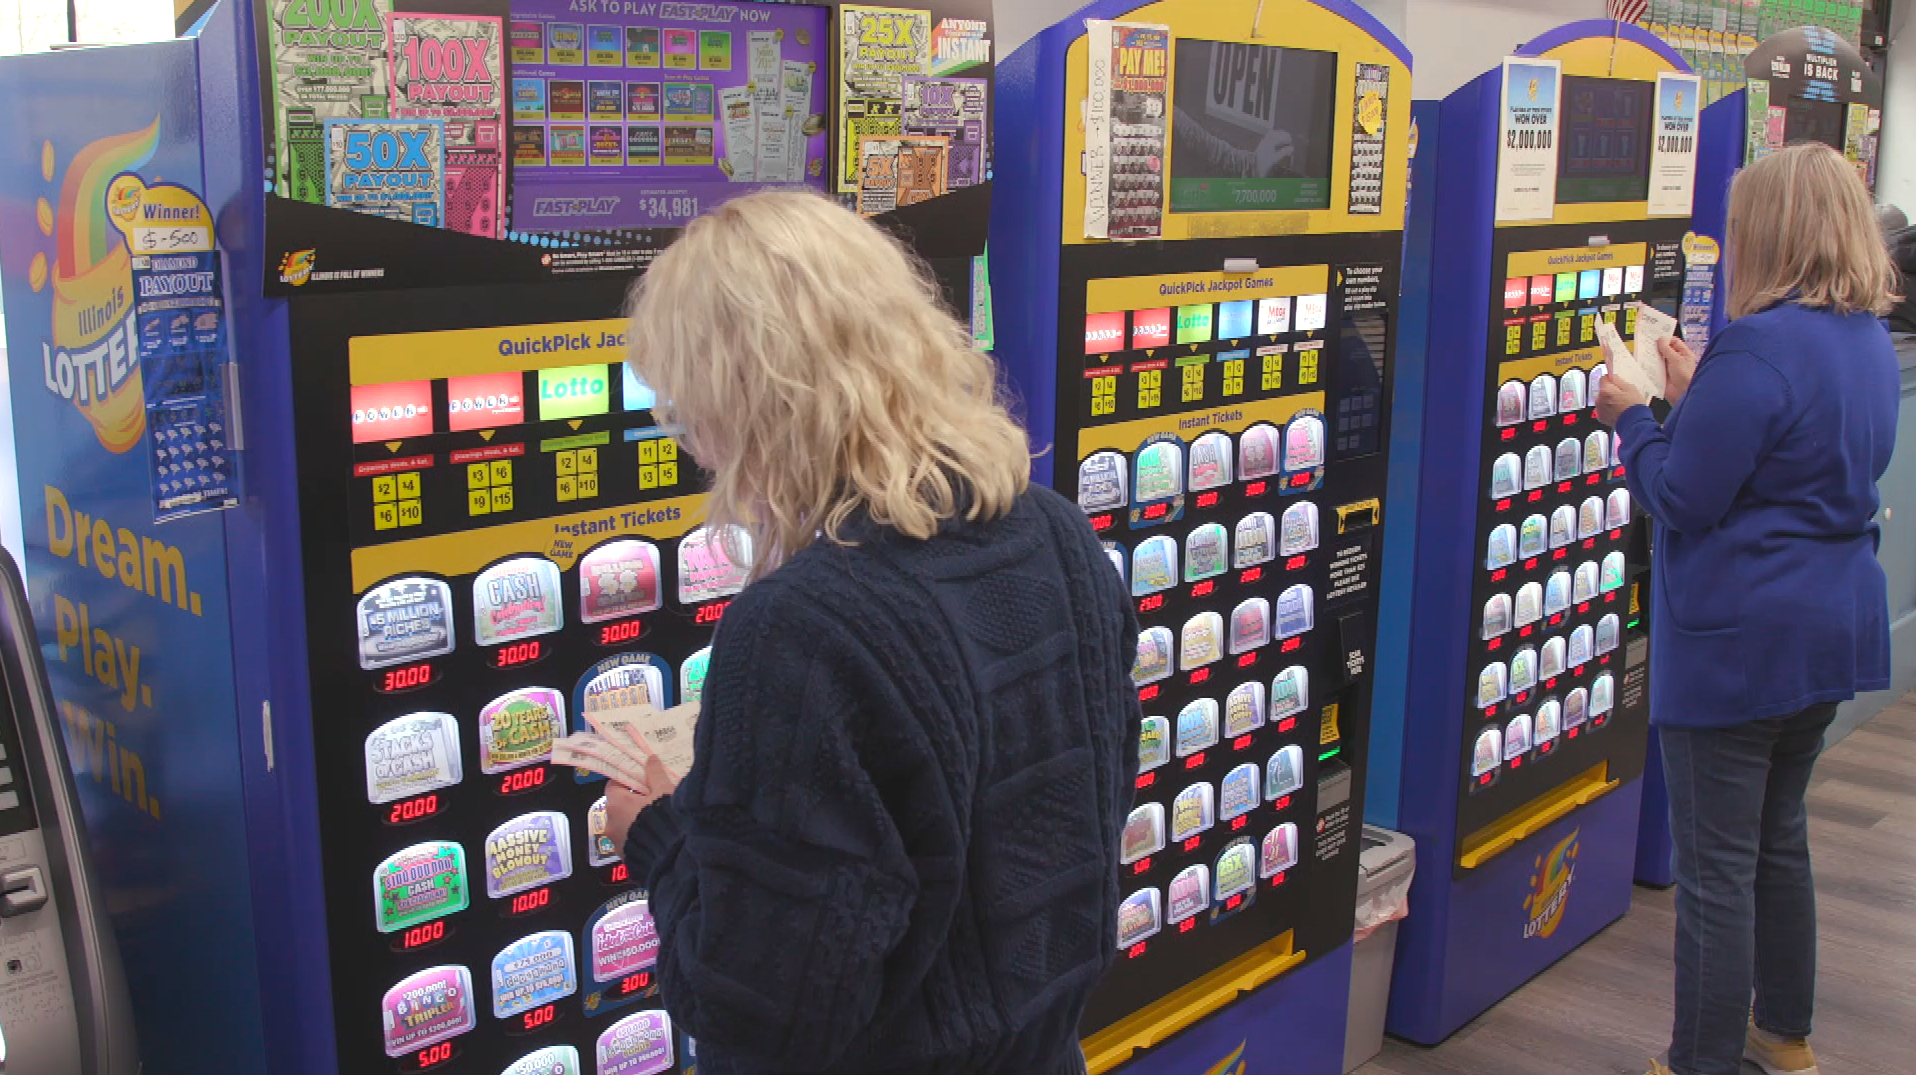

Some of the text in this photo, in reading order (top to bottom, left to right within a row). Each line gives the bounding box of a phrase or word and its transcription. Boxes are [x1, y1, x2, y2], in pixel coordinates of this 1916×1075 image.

[283, 0, 382, 29] 200X
[569, 0, 771, 22] ASK TO PLAY FAST PLAY NOW
[284, 31, 384, 47] PAYOUT
[860, 17, 915, 45] 25X
[402, 37, 491, 82] 100X
[859, 47, 917, 61] PAYOUT
[938, 37, 991, 62] INSTANT
[1806, 54, 1837, 66] MULTIPLIER
[1119, 48, 1167, 77] PAY ME!
[1804, 63, 1814, 77] IS
[1816, 65, 1838, 80] BACK
[408, 84, 493, 101] PAYOUT
[1213, 41, 1278, 122] OPEN
[920, 86, 954, 105] 10X
[1515, 114, 1547, 124] WON OVER
[345, 131, 431, 169] 50X
[1507, 129, 1552, 152] $2,000,000
[867, 157, 894, 176] 5X
[343, 172, 434, 188] PAYOUT
[1090, 145, 1105, 225] WINNER
[143, 204, 200, 220] Winner!
[534, 197, 619, 216] FAST PLAY
[640, 197, 699, 220] $34,981
[139, 272, 214, 297] PAYOUT
[1160, 277, 1273, 295] QuickPick Jackpot Games
[78, 286, 124, 337] Illinois
[1177, 314, 1210, 329] Lotto
[500, 333, 591, 356] QuickPick
[541, 377, 604, 399] Lotto
[1179, 410, 1243, 430] Instant Tickets
[555, 506, 681, 536] Instant Tickets
[45, 484, 203, 616] Dream.
[488, 573, 541, 606] CASH
[386, 603, 439, 623] MILLION
[695, 602, 731, 623] 20.0
[601, 620, 641, 644] 30.00
[54, 594, 152, 712] Play.
[498, 642, 540, 667] 30.00
[385, 665, 431, 691] 30.00
[491, 705, 549, 732] 20 YEARS
[509, 720, 551, 745] CASH
[371, 731, 435, 762] STACKS
[61, 700, 161, 820] Win.
[391, 751, 436, 777] CASH
[501, 767, 545, 793] 20.00
[390, 796, 437, 823] 20.00
[497, 843, 540, 863] MONEY
[493, 853, 548, 879] BLOWOUT
[408, 879, 435, 897] CASH
[1523, 861, 1576, 939] LOTTERY
[512, 888, 550, 914] 10.00
[405, 921, 444, 949] 10.00
[397, 987, 457, 1015] BINGO
[404, 1002, 455, 1027] TRIPLER
[524, 1005, 554, 1029] 5.00
[419, 1042, 452, 1068] 5.00
